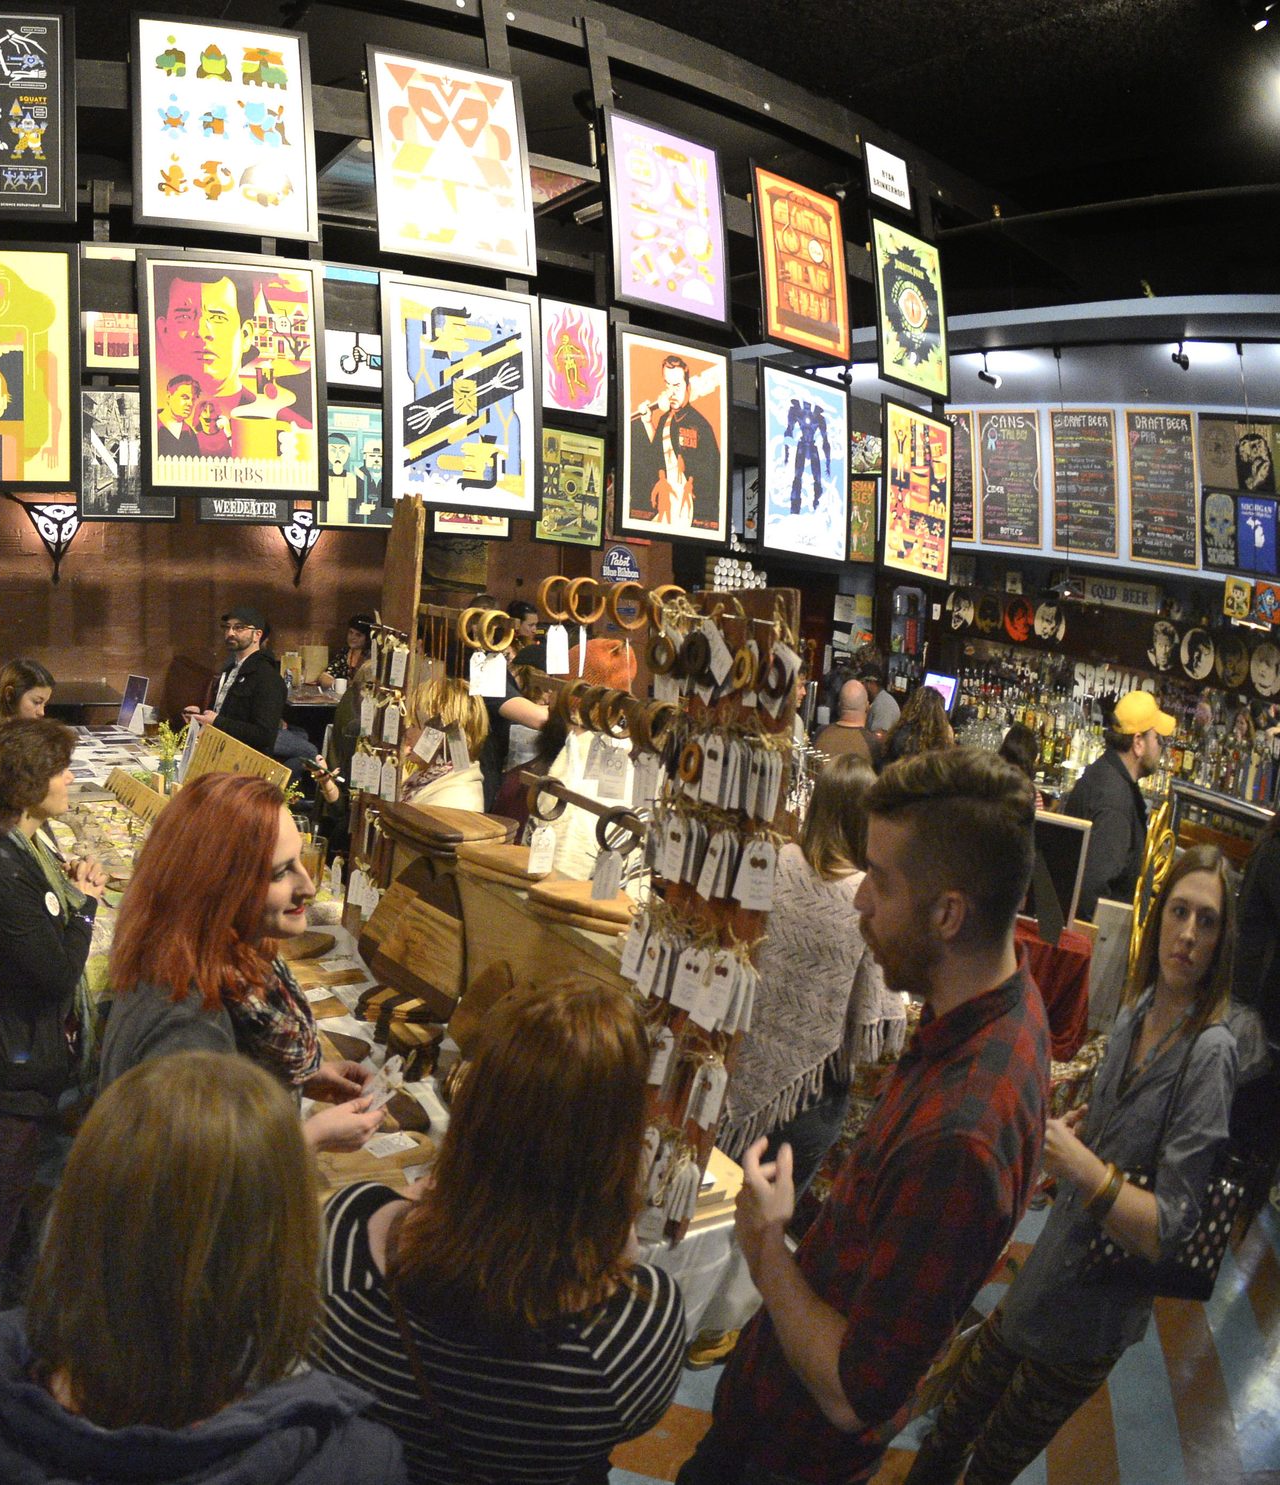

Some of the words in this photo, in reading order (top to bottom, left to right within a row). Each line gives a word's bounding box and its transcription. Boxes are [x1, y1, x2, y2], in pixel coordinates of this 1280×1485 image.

[990, 415, 1025, 428] CANS
[1064, 415, 1086, 427] DRAFT
[1087, 415, 1108, 428] BEER
[1135, 415, 1165, 430] DRAFT
[1166, 418, 1188, 431] BEER
[213, 499, 276, 515] WEEDEATER
[609, 551, 631, 567] Pabst
[602, 566, 617, 577] Blue
[617, 566, 639, 578] Ribbon
[1091, 584, 1117, 601] COLD
[1123, 587, 1149, 606] BEER
